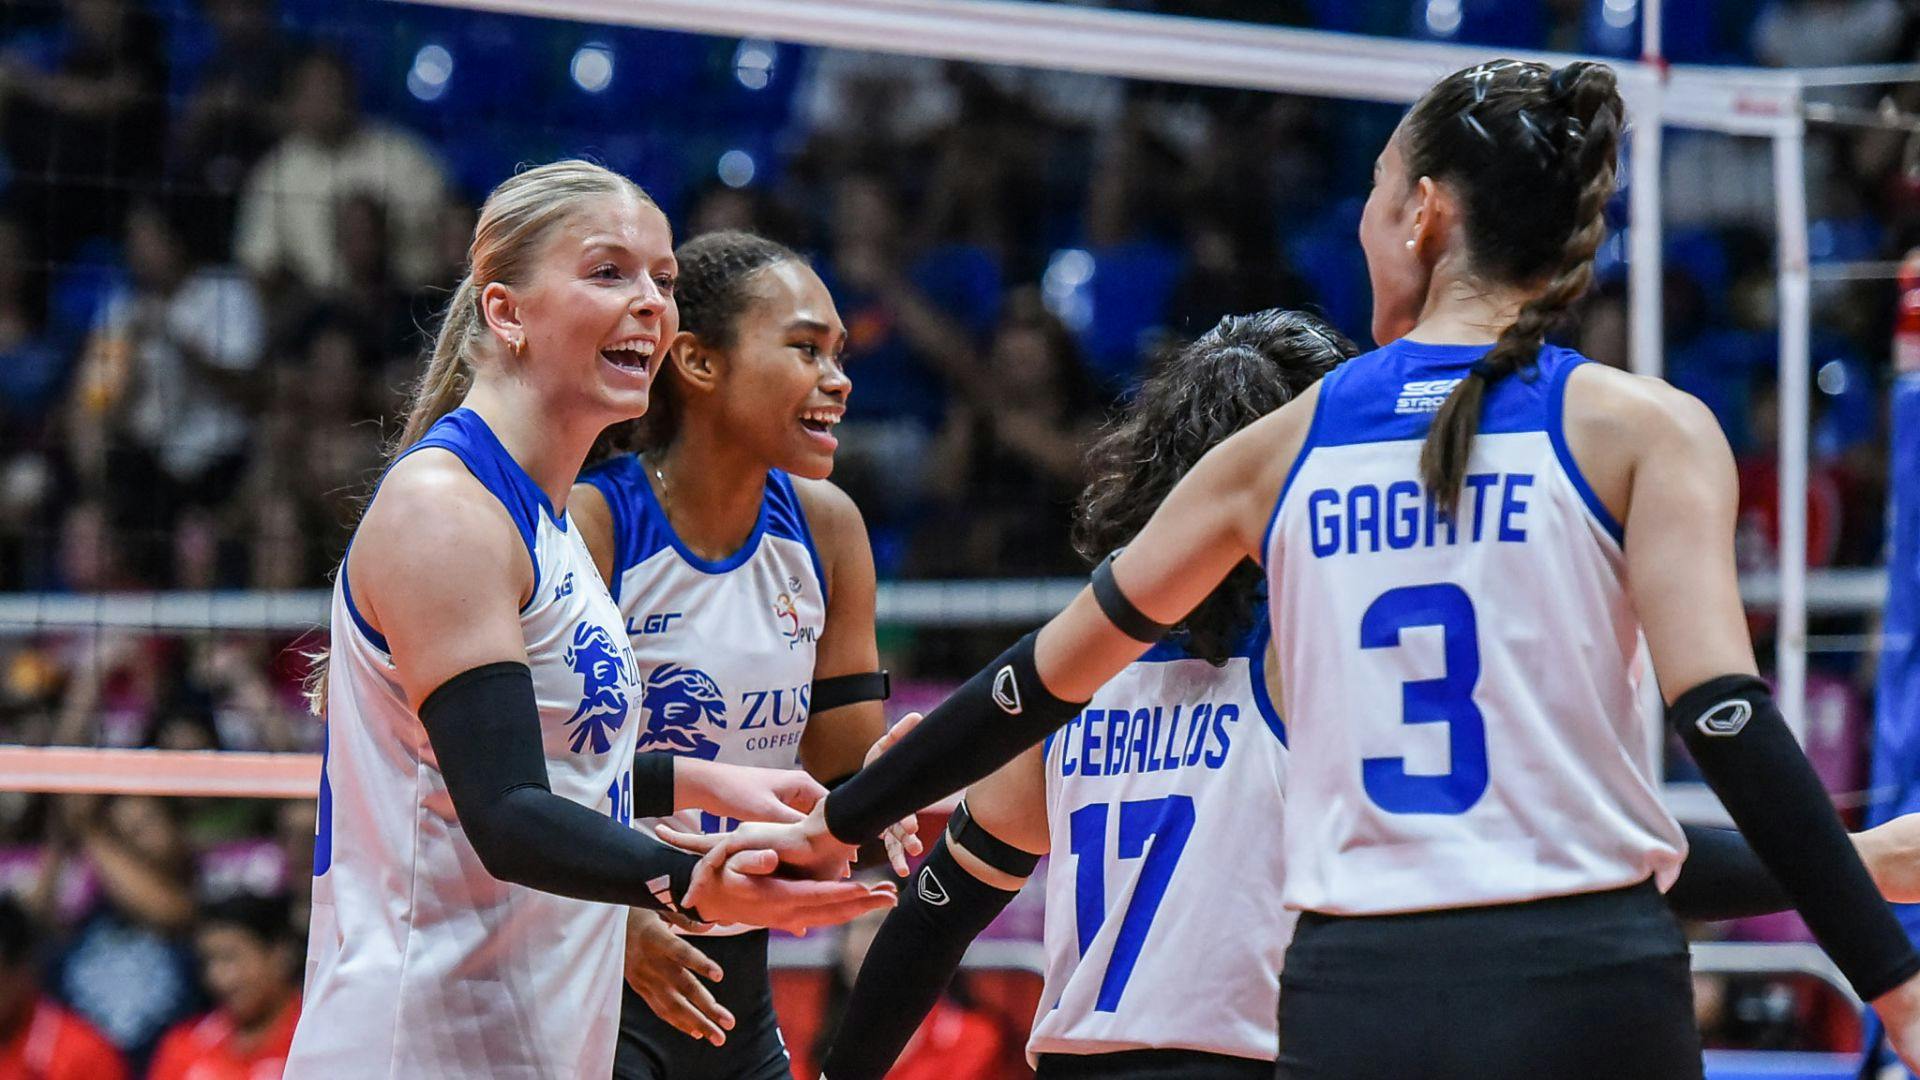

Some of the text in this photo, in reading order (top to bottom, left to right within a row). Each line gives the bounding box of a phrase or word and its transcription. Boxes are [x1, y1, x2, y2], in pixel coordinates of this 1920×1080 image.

[1396, 397, 1446, 408] STRO
[1308, 473, 1535, 559] GAGATE
[739, 683, 809, 730] ZUS
[1360, 583, 1489, 816] 3
[745, 730, 802, 751] COFFEE
[1062, 703, 1240, 777] CEBALLOS
[1068, 794, 1197, 1013] 17
